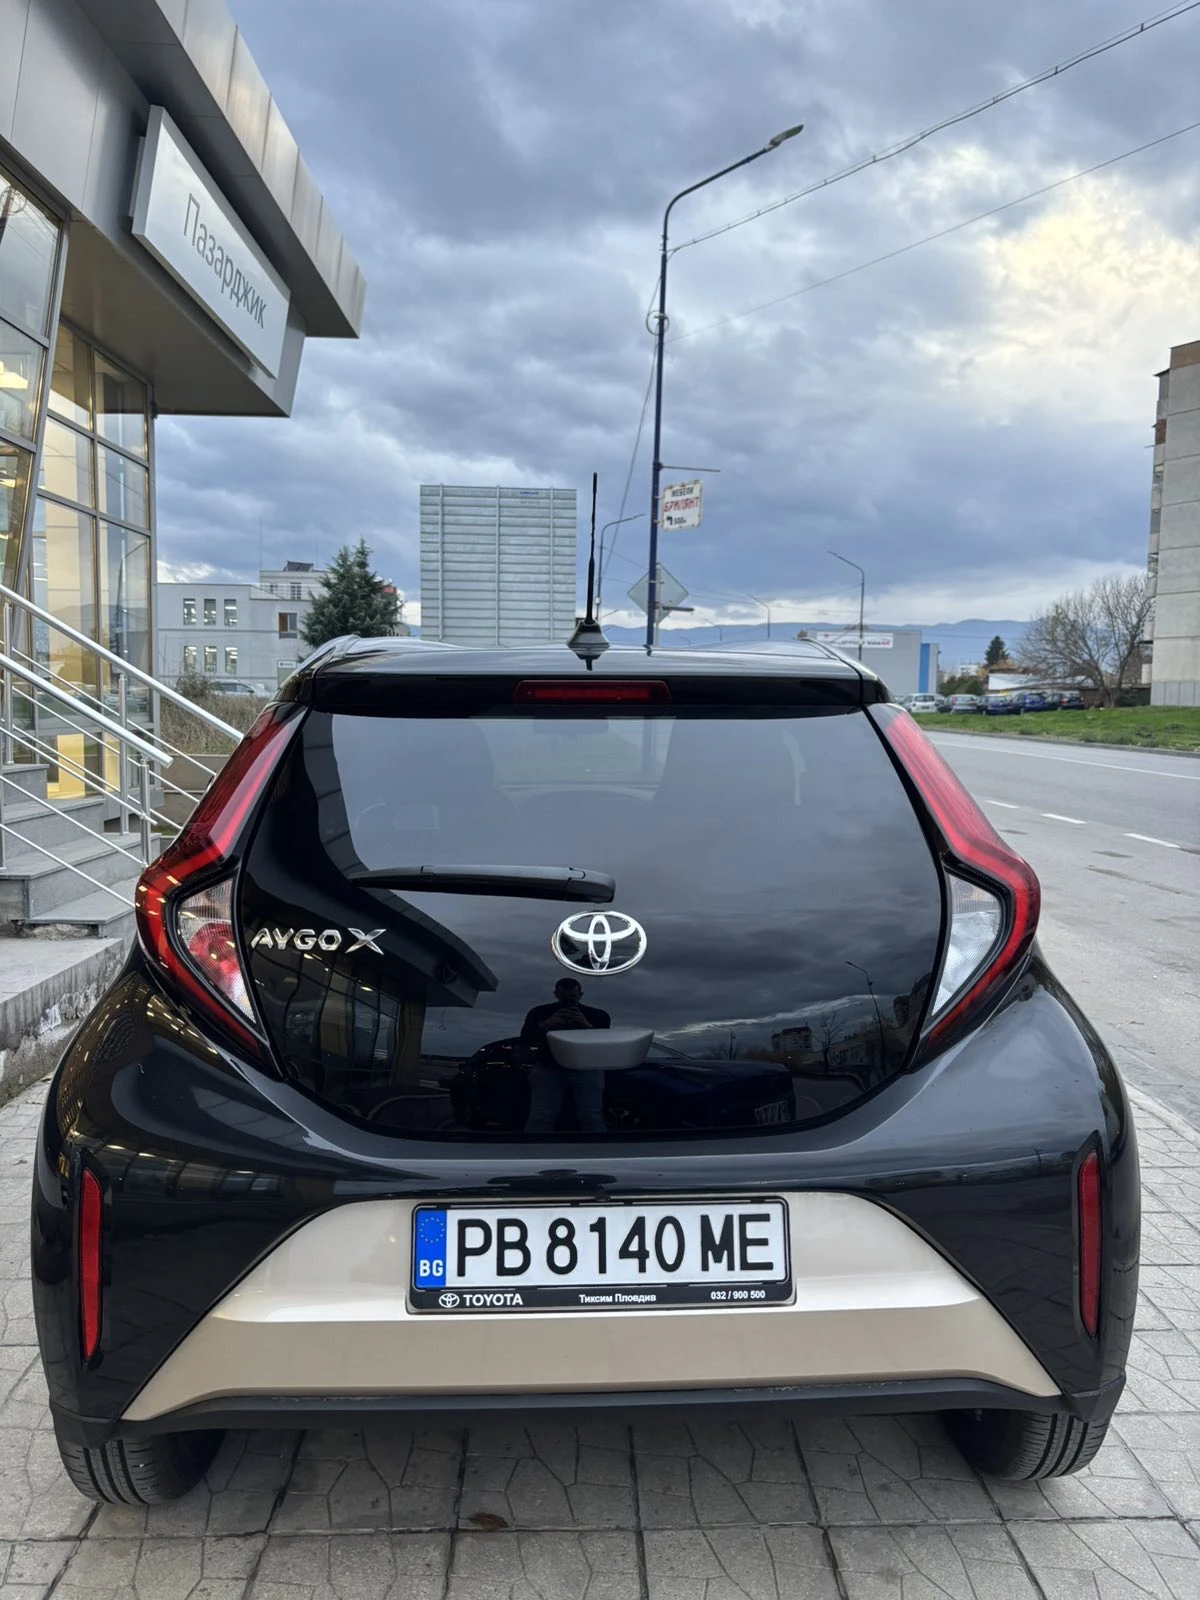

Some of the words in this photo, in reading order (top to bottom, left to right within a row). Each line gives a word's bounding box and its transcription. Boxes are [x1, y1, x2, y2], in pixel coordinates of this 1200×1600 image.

[184, 193, 267, 329] Пазарджик
[251, 928, 342, 951] AYGO
[344, 928, 387, 955] X
[457, 1218, 531, 1277] PB
[546, 1215, 686, 1275] 8140
[700, 1213, 774, 1272] ME
[419, 1259, 443, 1277] BG
[463, 1293, 524, 1307] TOYOTA
[579, 1294, 613, 1303] Тиксим
[614, 1293, 657, 1303] Пловдив
[711, 1290, 727, 1300] 032
[732, 1290, 749, 1300] 900
[750, 1289, 766, 1299] 500
